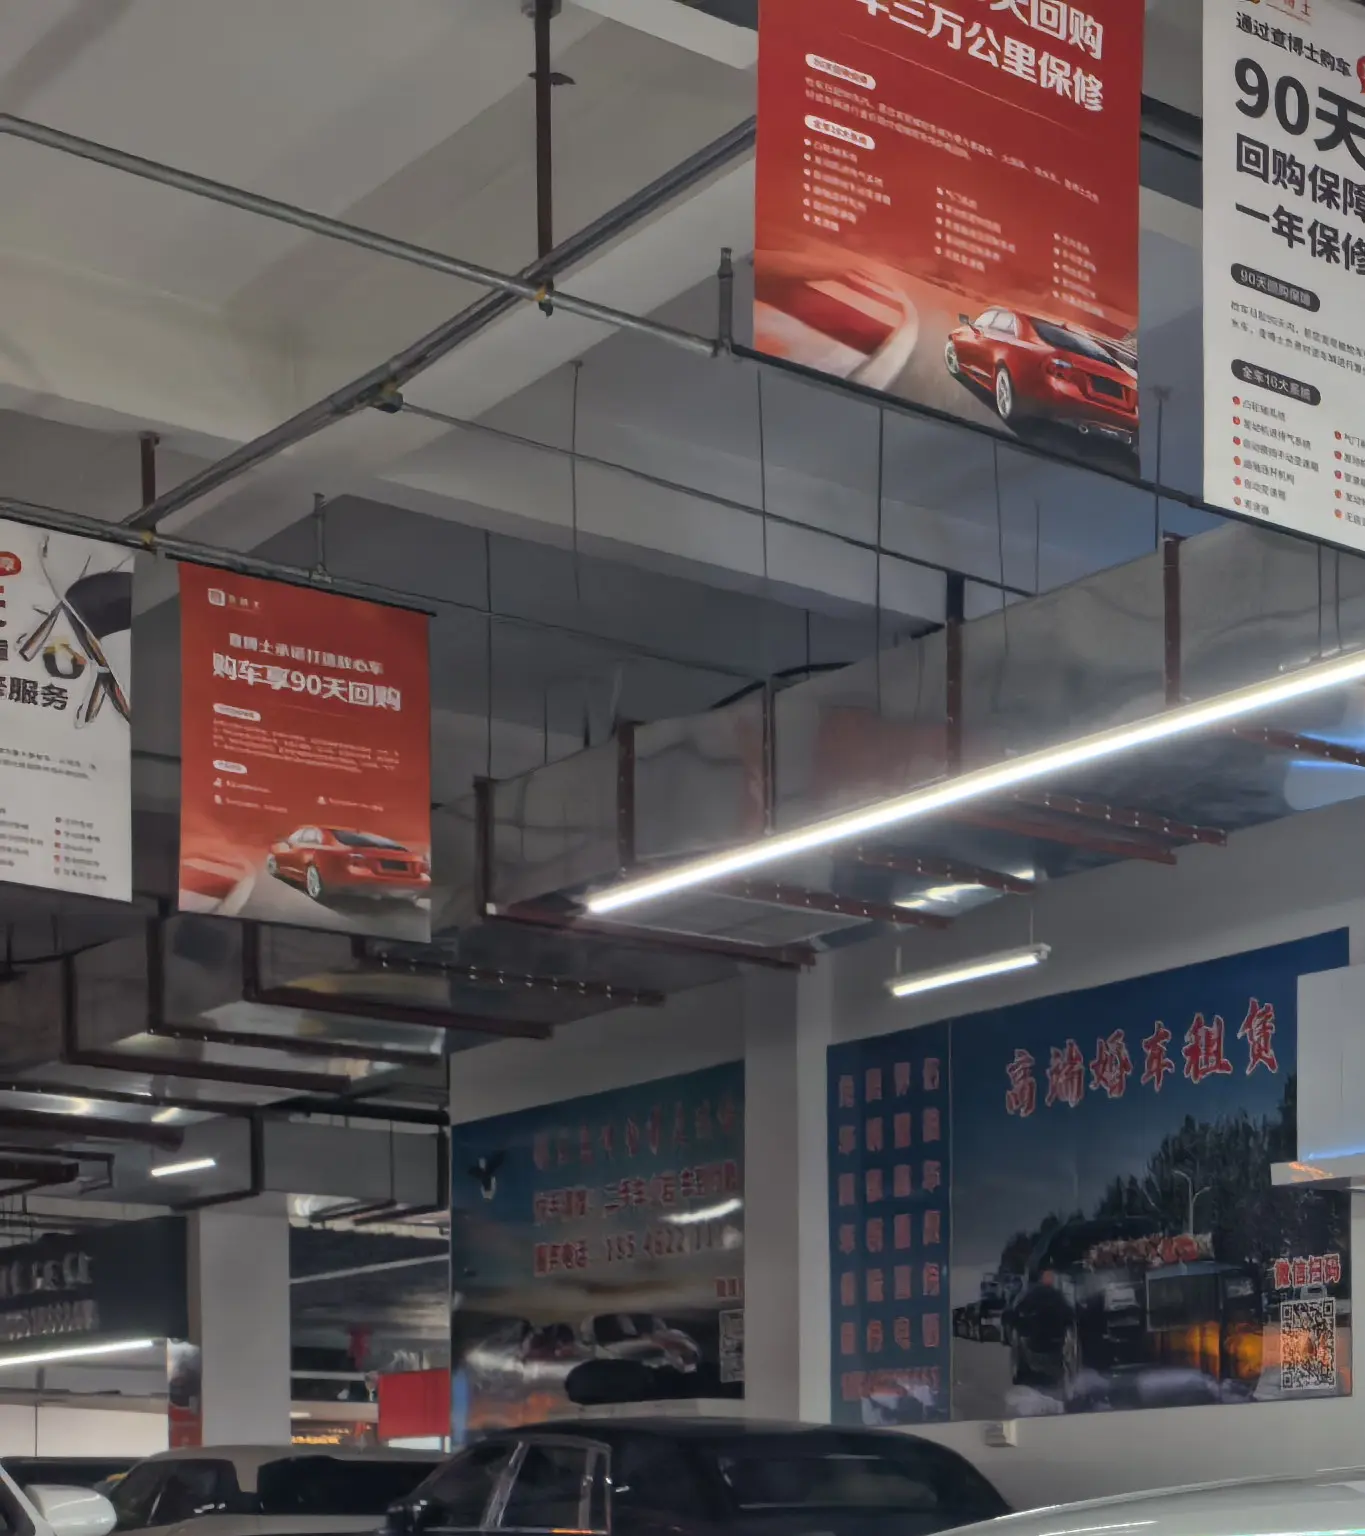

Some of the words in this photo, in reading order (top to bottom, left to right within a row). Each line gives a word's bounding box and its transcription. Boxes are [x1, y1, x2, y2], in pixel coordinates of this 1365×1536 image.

[0, 676, 69, 711] 服务
[212, 650, 402, 712] 购车享90天回购
[1005, 995, 1280, 1119] 高端婚车租赁
